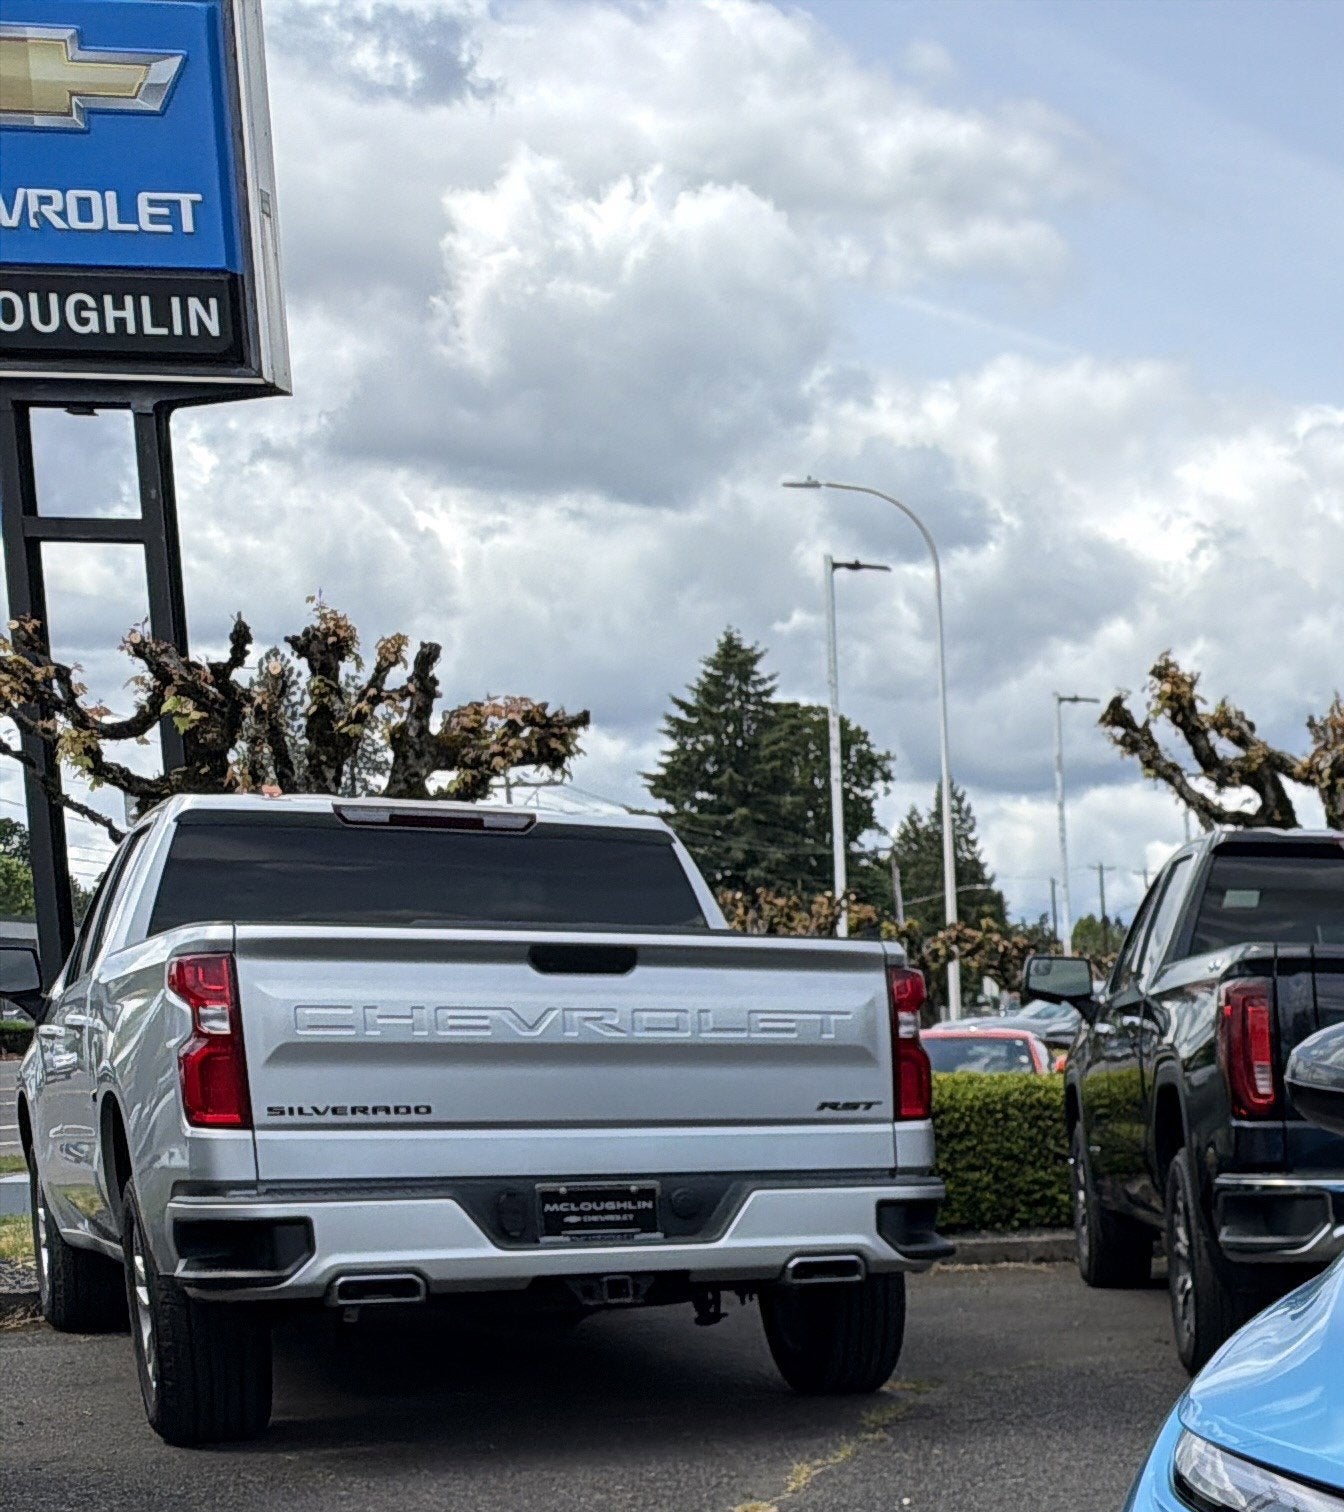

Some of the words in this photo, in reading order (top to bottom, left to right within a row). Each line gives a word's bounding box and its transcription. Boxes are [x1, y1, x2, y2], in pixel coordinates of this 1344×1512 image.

[0, 290, 220, 337] OUGHLIN
[294, 1005, 853, 1039] CHEVROLET
[266, 1105, 432, 1117] SILVERADO
[816, 1101, 883, 1111] RST
[543, 1200, 653, 1213] MCLOUGHLIN
